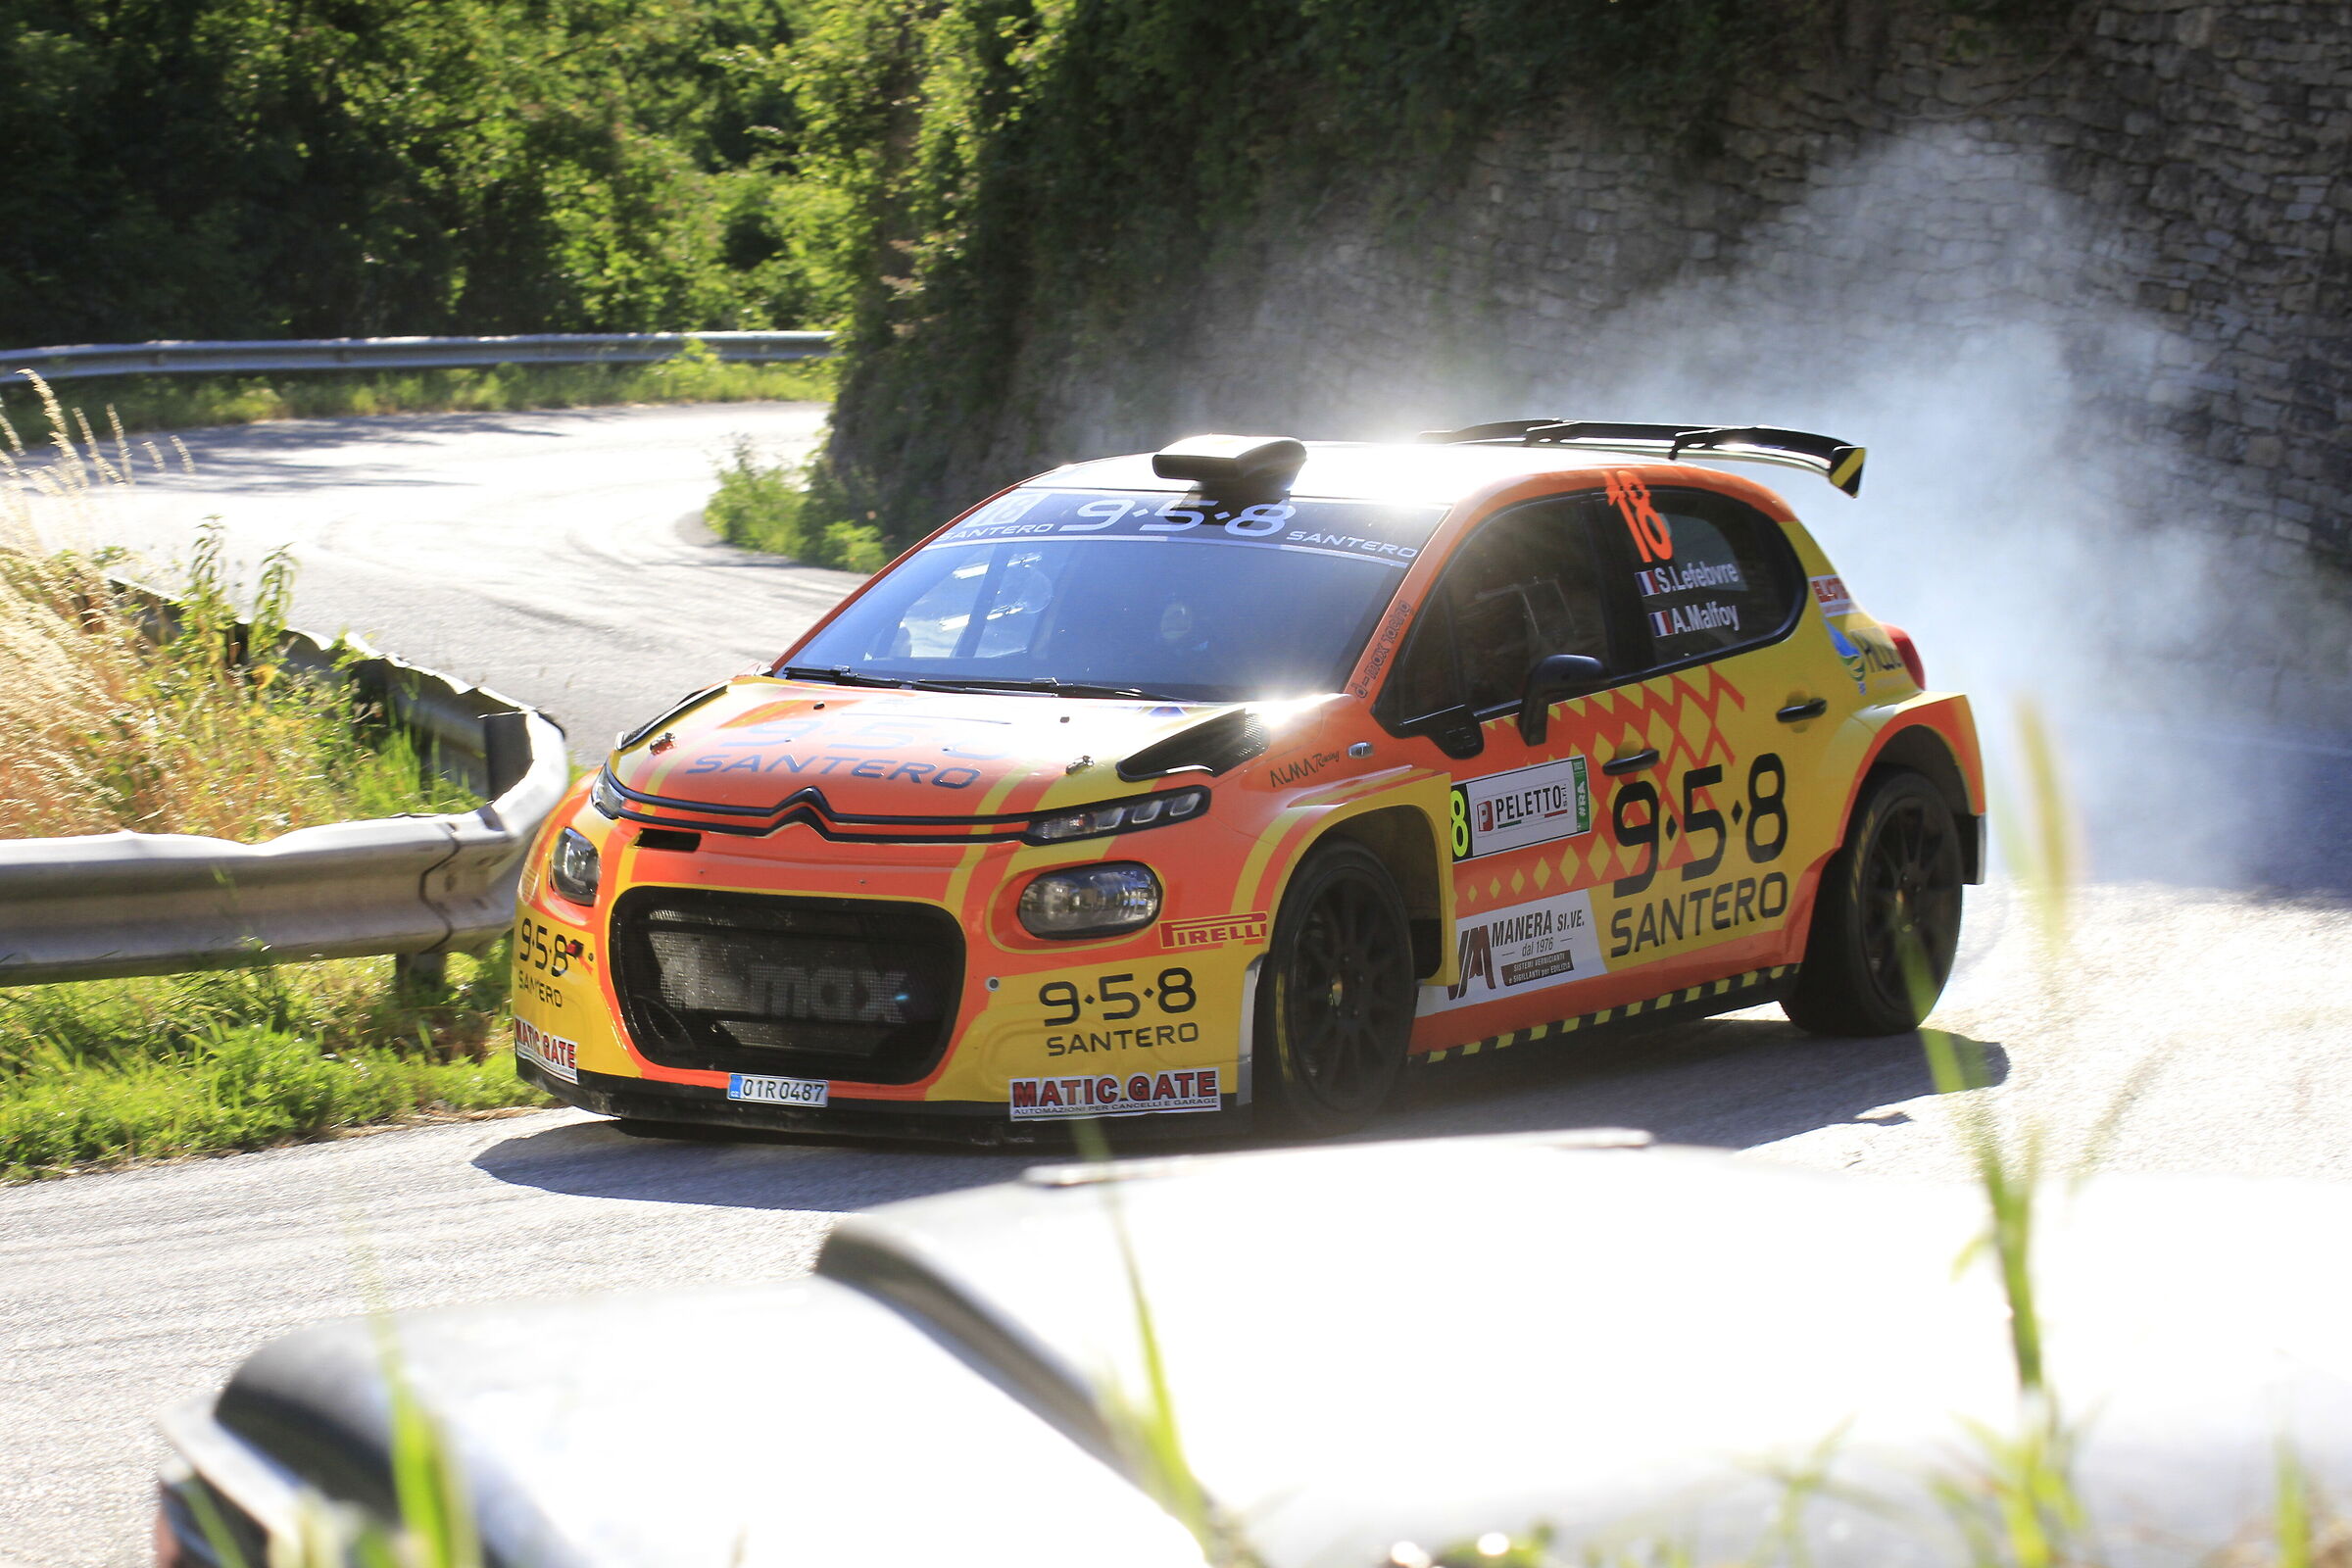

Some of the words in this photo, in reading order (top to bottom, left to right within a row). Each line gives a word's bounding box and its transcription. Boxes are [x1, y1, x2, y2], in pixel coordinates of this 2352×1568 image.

[938, 523, 1054, 542] SANTERO
[1602, 470, 1673, 563] 18
[1287, 530, 1418, 559] SANTERO
[686, 753, 982, 790] SANTERO
[1269, 759, 1316, 787] ALMA
[1495, 785, 1562, 822] PELETTO
[1161, 912, 1267, 948] PIRELLI
[1492, 909, 1552, 948] MANERA
[1610, 871, 1788, 958] SANTERO
[1522, 943, 1534, 957] dal
[1536, 937, 1553, 954] 1976
[543, 1035, 576, 1069] GATE
[1047, 1022, 1199, 1056] SANTERO
[1012, 1078, 1118, 1107] MATIC
[1128, 1071, 1216, 1102] GATE
[1014, 1105, 1086, 1115] AUTOMAZIONI
[1111, 1100, 1161, 1110] CANCELLI
[1173, 1097, 1217, 1106] GARAGE
